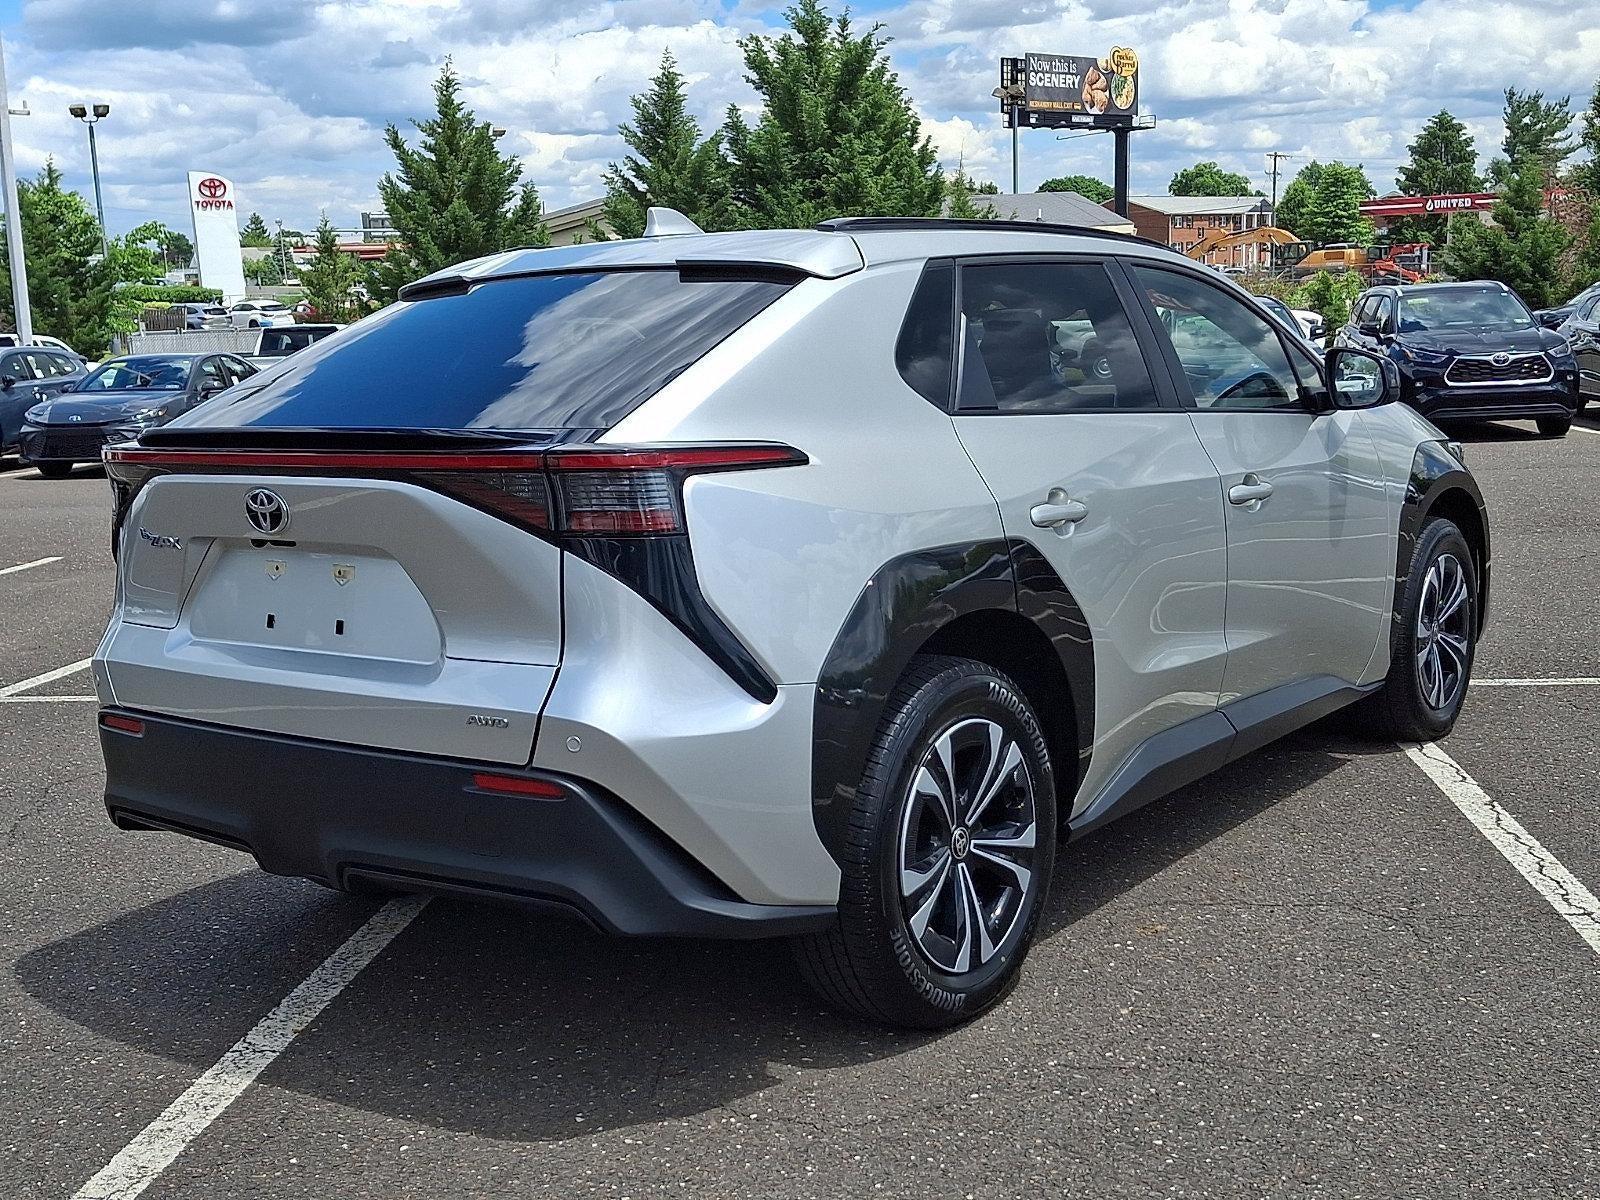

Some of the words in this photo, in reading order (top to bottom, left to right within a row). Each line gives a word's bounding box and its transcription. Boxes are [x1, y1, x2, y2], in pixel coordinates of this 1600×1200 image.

[1029, 56, 1050, 71] Now
[1052, 59, 1068, 73] this
[1069, 60, 1077, 73] is
[1029, 71, 1080, 89] SCENERY
[194, 200, 233, 210] TOYOTA
[1434, 198, 1472, 209] UNITED
[466, 714, 509, 729] AWD
[989, 681, 1051, 775] BRIDGESTONE
[889, 927, 967, 1012] BRIDGESTONE
